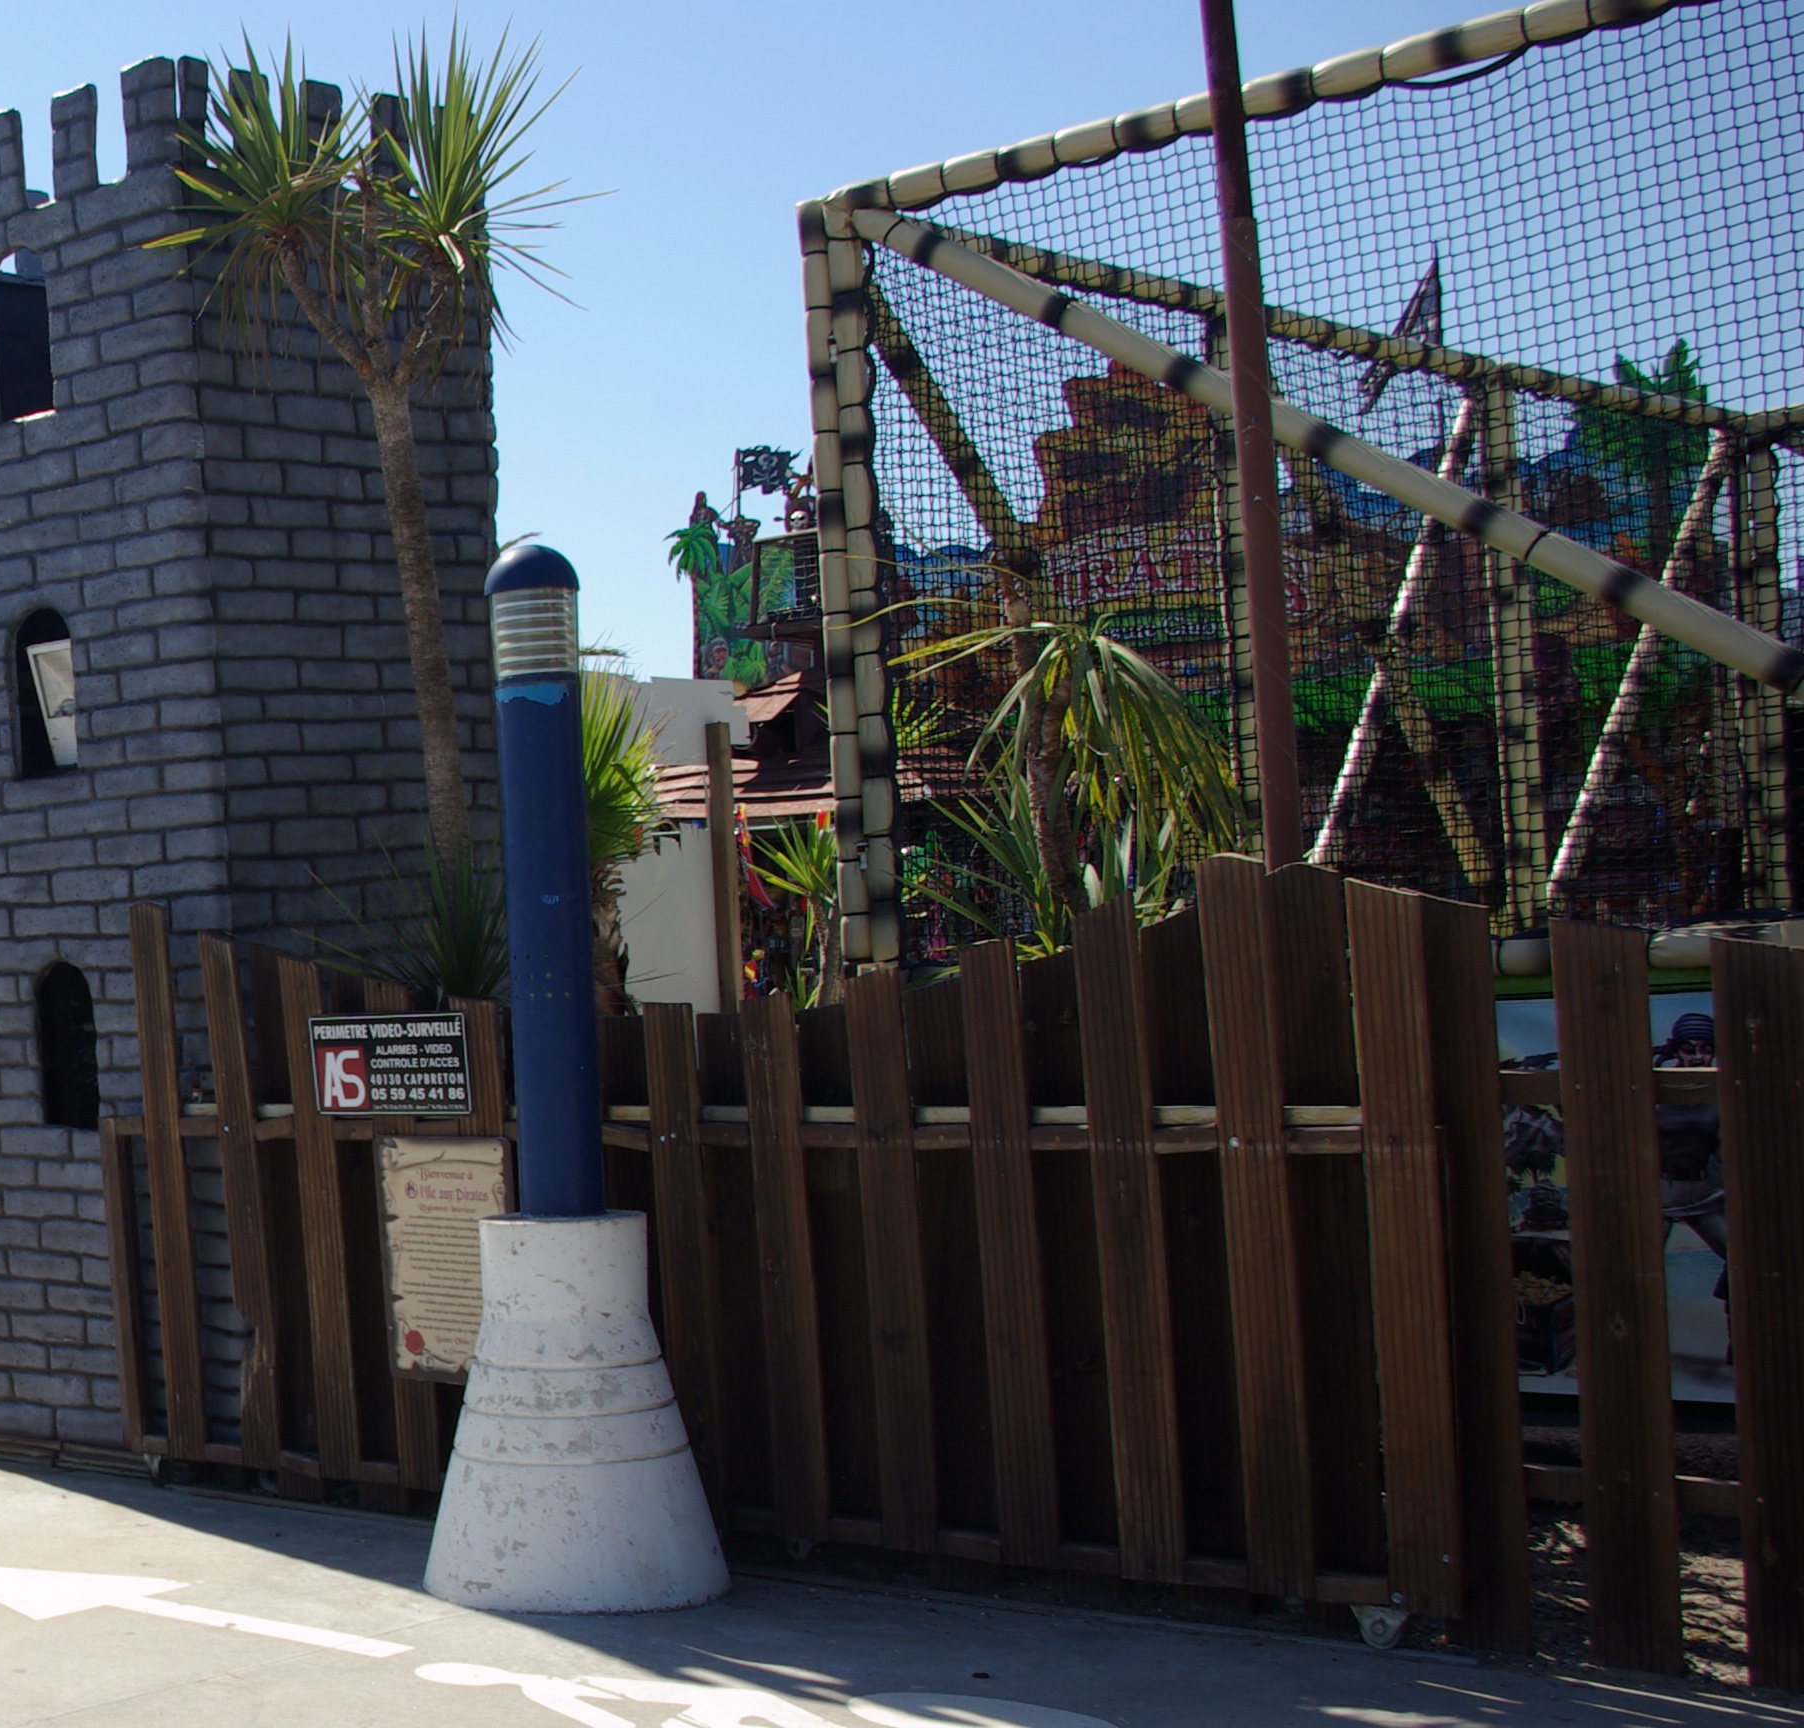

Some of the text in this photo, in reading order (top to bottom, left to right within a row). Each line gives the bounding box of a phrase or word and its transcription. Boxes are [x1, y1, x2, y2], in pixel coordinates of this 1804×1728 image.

[313, 1017, 461, 1040] PERIMETRE VIDEO-SURVEILLÉ
[375, 1045, 418, 1055] ALARMES
[424, 1043, 453, 1054] VIDEO
[370, 1056, 460, 1069] CONTROLE D'ACCES
[323, 1050, 366, 1108] AS
[369, 1072, 465, 1086] 40130 CAPBRETON
[370, 1087, 466, 1101] 05 59 45 41 86
[416, 1166, 465, 1181] Bienvenue
